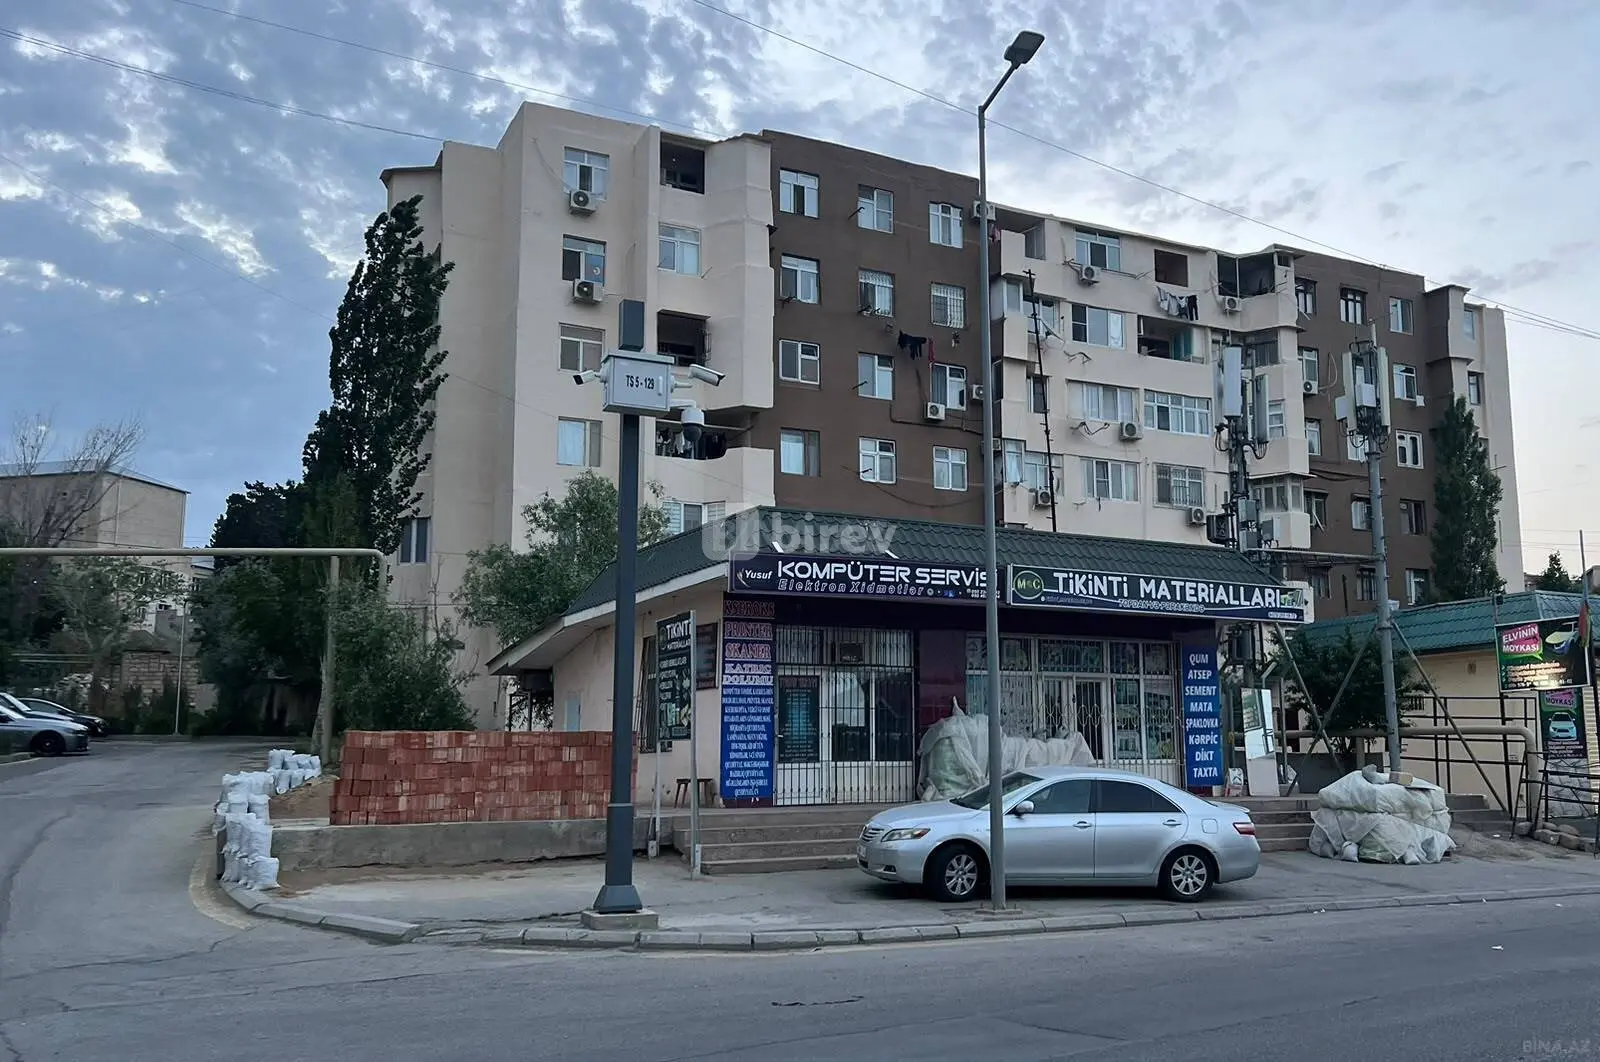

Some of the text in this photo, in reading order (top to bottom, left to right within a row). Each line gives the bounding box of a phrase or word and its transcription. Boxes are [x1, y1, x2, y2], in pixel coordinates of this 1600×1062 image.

[625, 375, 634, 388] TS
[744, 569, 773, 580] Yusuf
[777, 560, 911, 583] KOMPÜTER
[777, 578, 924, 596] Elektron Xidmətlər
[1139, 577, 1280, 608] MATERİALLARI
[1502, 624, 1538, 643] ELVİNİN
[725, 643, 772, 659] SKANER
[1502, 644, 1539, 653] MOYKASI
[1189, 654, 1209, 665] QUM
[1187, 670, 1212, 680] ATSEP
[1185, 685, 1217, 696] SEMENT
[1189, 702, 1213, 712] MATA
[1185, 718, 1218, 731] ŞPAKLOVKA
[1188, 732, 1219, 745] KƏRPİC
[1195, 748, 1214, 761] DİKT
[1193, 767, 1218, 778] TAXTA
